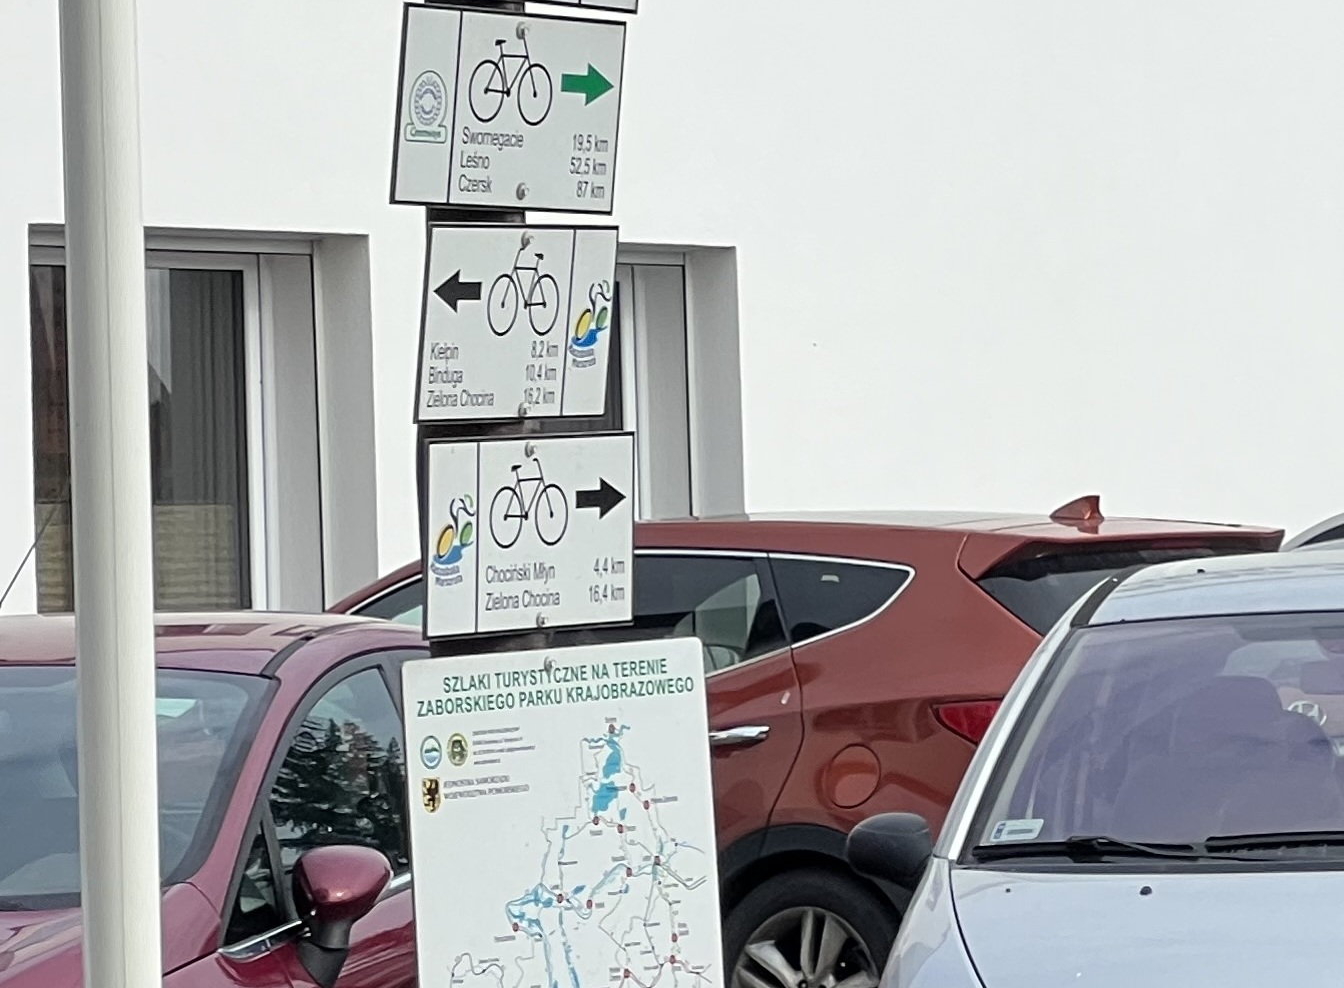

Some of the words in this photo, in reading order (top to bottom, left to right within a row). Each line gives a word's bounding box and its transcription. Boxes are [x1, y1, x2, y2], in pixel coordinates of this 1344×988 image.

[572, 134, 592, 153] 19,5
[594, 134, 608, 152] km
[460, 150, 490, 169] Leśno
[569, 156, 591, 177] 52,5
[592, 158, 606, 175] km
[459, 174, 492, 193] Czersk
[576, 180, 589, 198] 87
[590, 181, 604, 199] km
[530, 340, 545, 360] 8,2
[546, 340, 558, 357] km
[525, 363, 542, 382] 10,4
[544, 363, 556, 380] km
[427, 390, 458, 407] Zielona
[524, 387, 541, 406] 16,2
[543, 387, 555, 404] km
[486, 563, 531, 583] Chociński
[533, 561, 555, 585] Młyn
[594, 557, 608, 578] 4,4
[611, 556, 625, 574] km
[485, 592, 520, 611] Zielona
[522, 588, 561, 608] Chocina
[589, 584, 608, 604] 16,4
[611, 584, 625, 601] km
[443, 673, 491, 694] SZLAKI
[494, 665, 587, 689] TURYSTYCZNE
[592, 662, 610, 680] NA
[613, 658, 668, 678] TERENIE
[417, 693, 515, 717] ZABORSKIEGO
[519, 688, 562, 709] PARKU
[566, 676, 695, 703] KRAJOBRAZOWEGO
